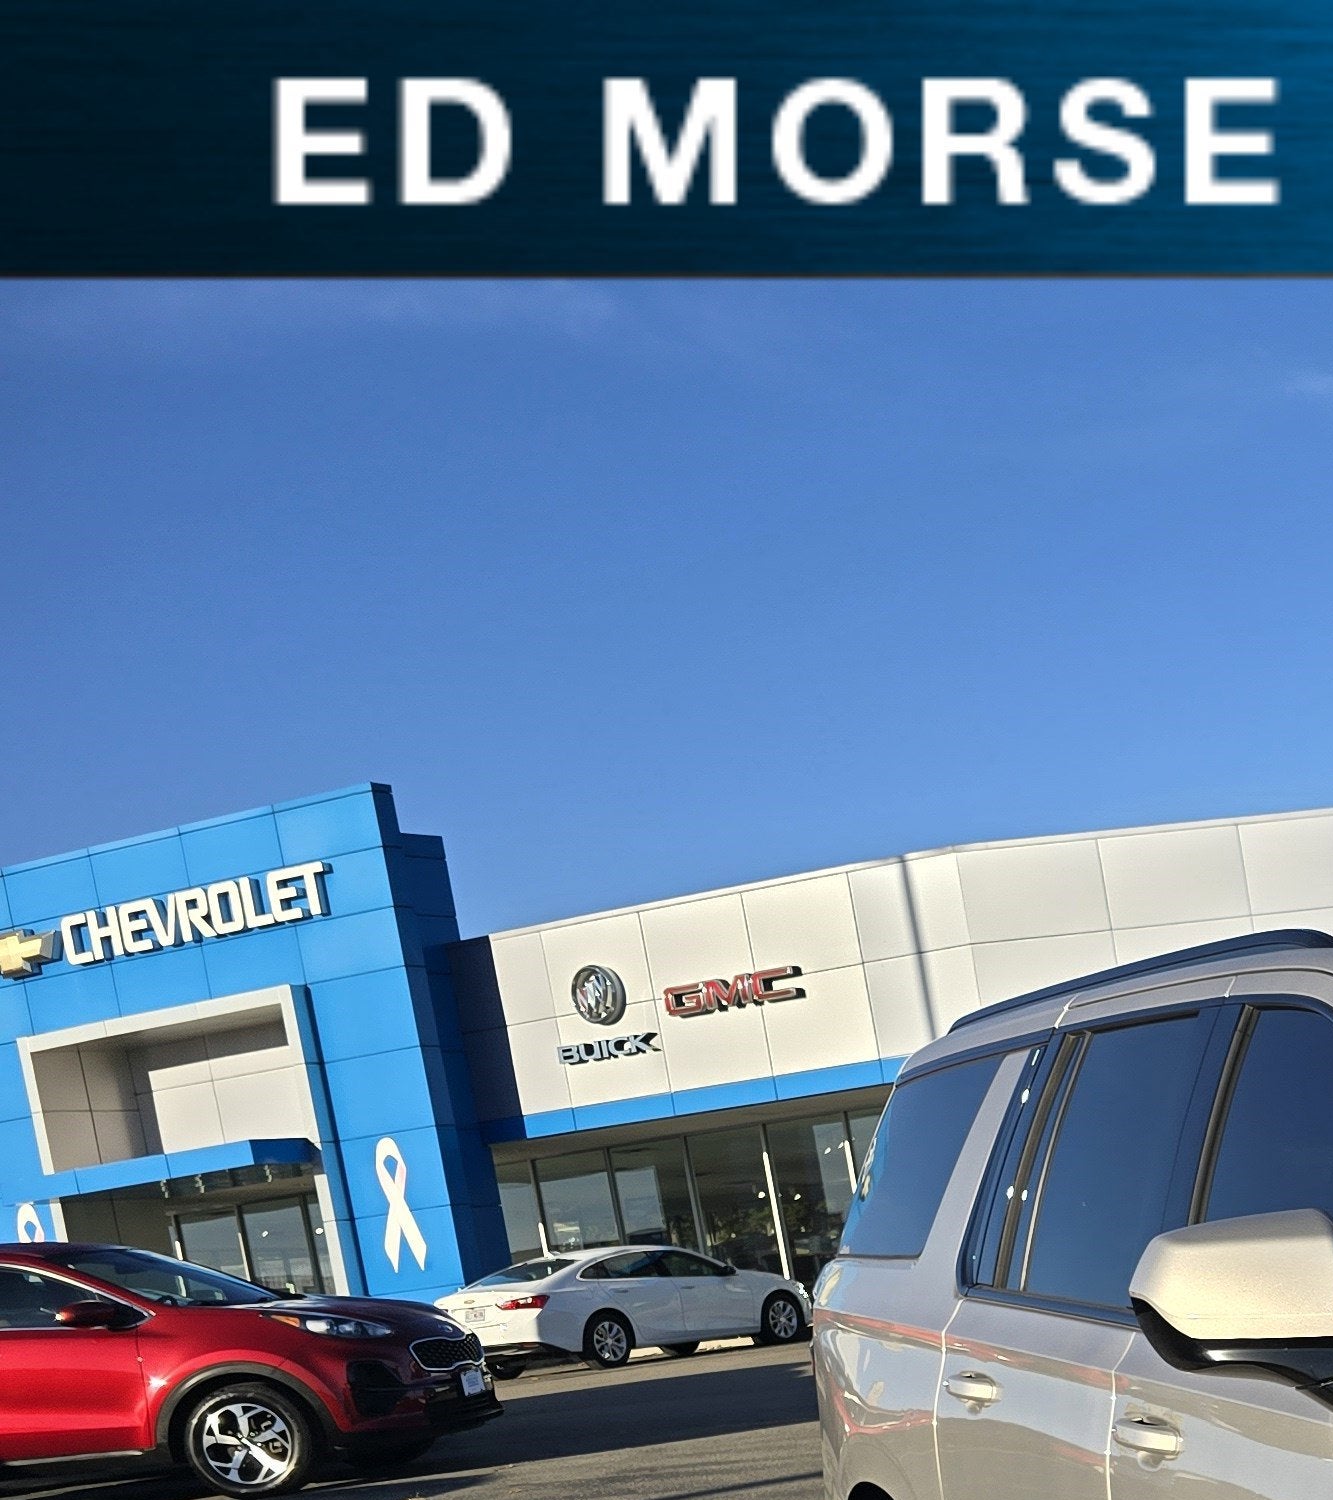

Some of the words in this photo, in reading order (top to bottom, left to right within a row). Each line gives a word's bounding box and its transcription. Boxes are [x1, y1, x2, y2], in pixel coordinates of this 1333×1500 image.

[60, 860, 329, 966] CHEVROLET
[663, 966, 800, 1017] GMC
[557, 1032, 661, 1065] BUICK
